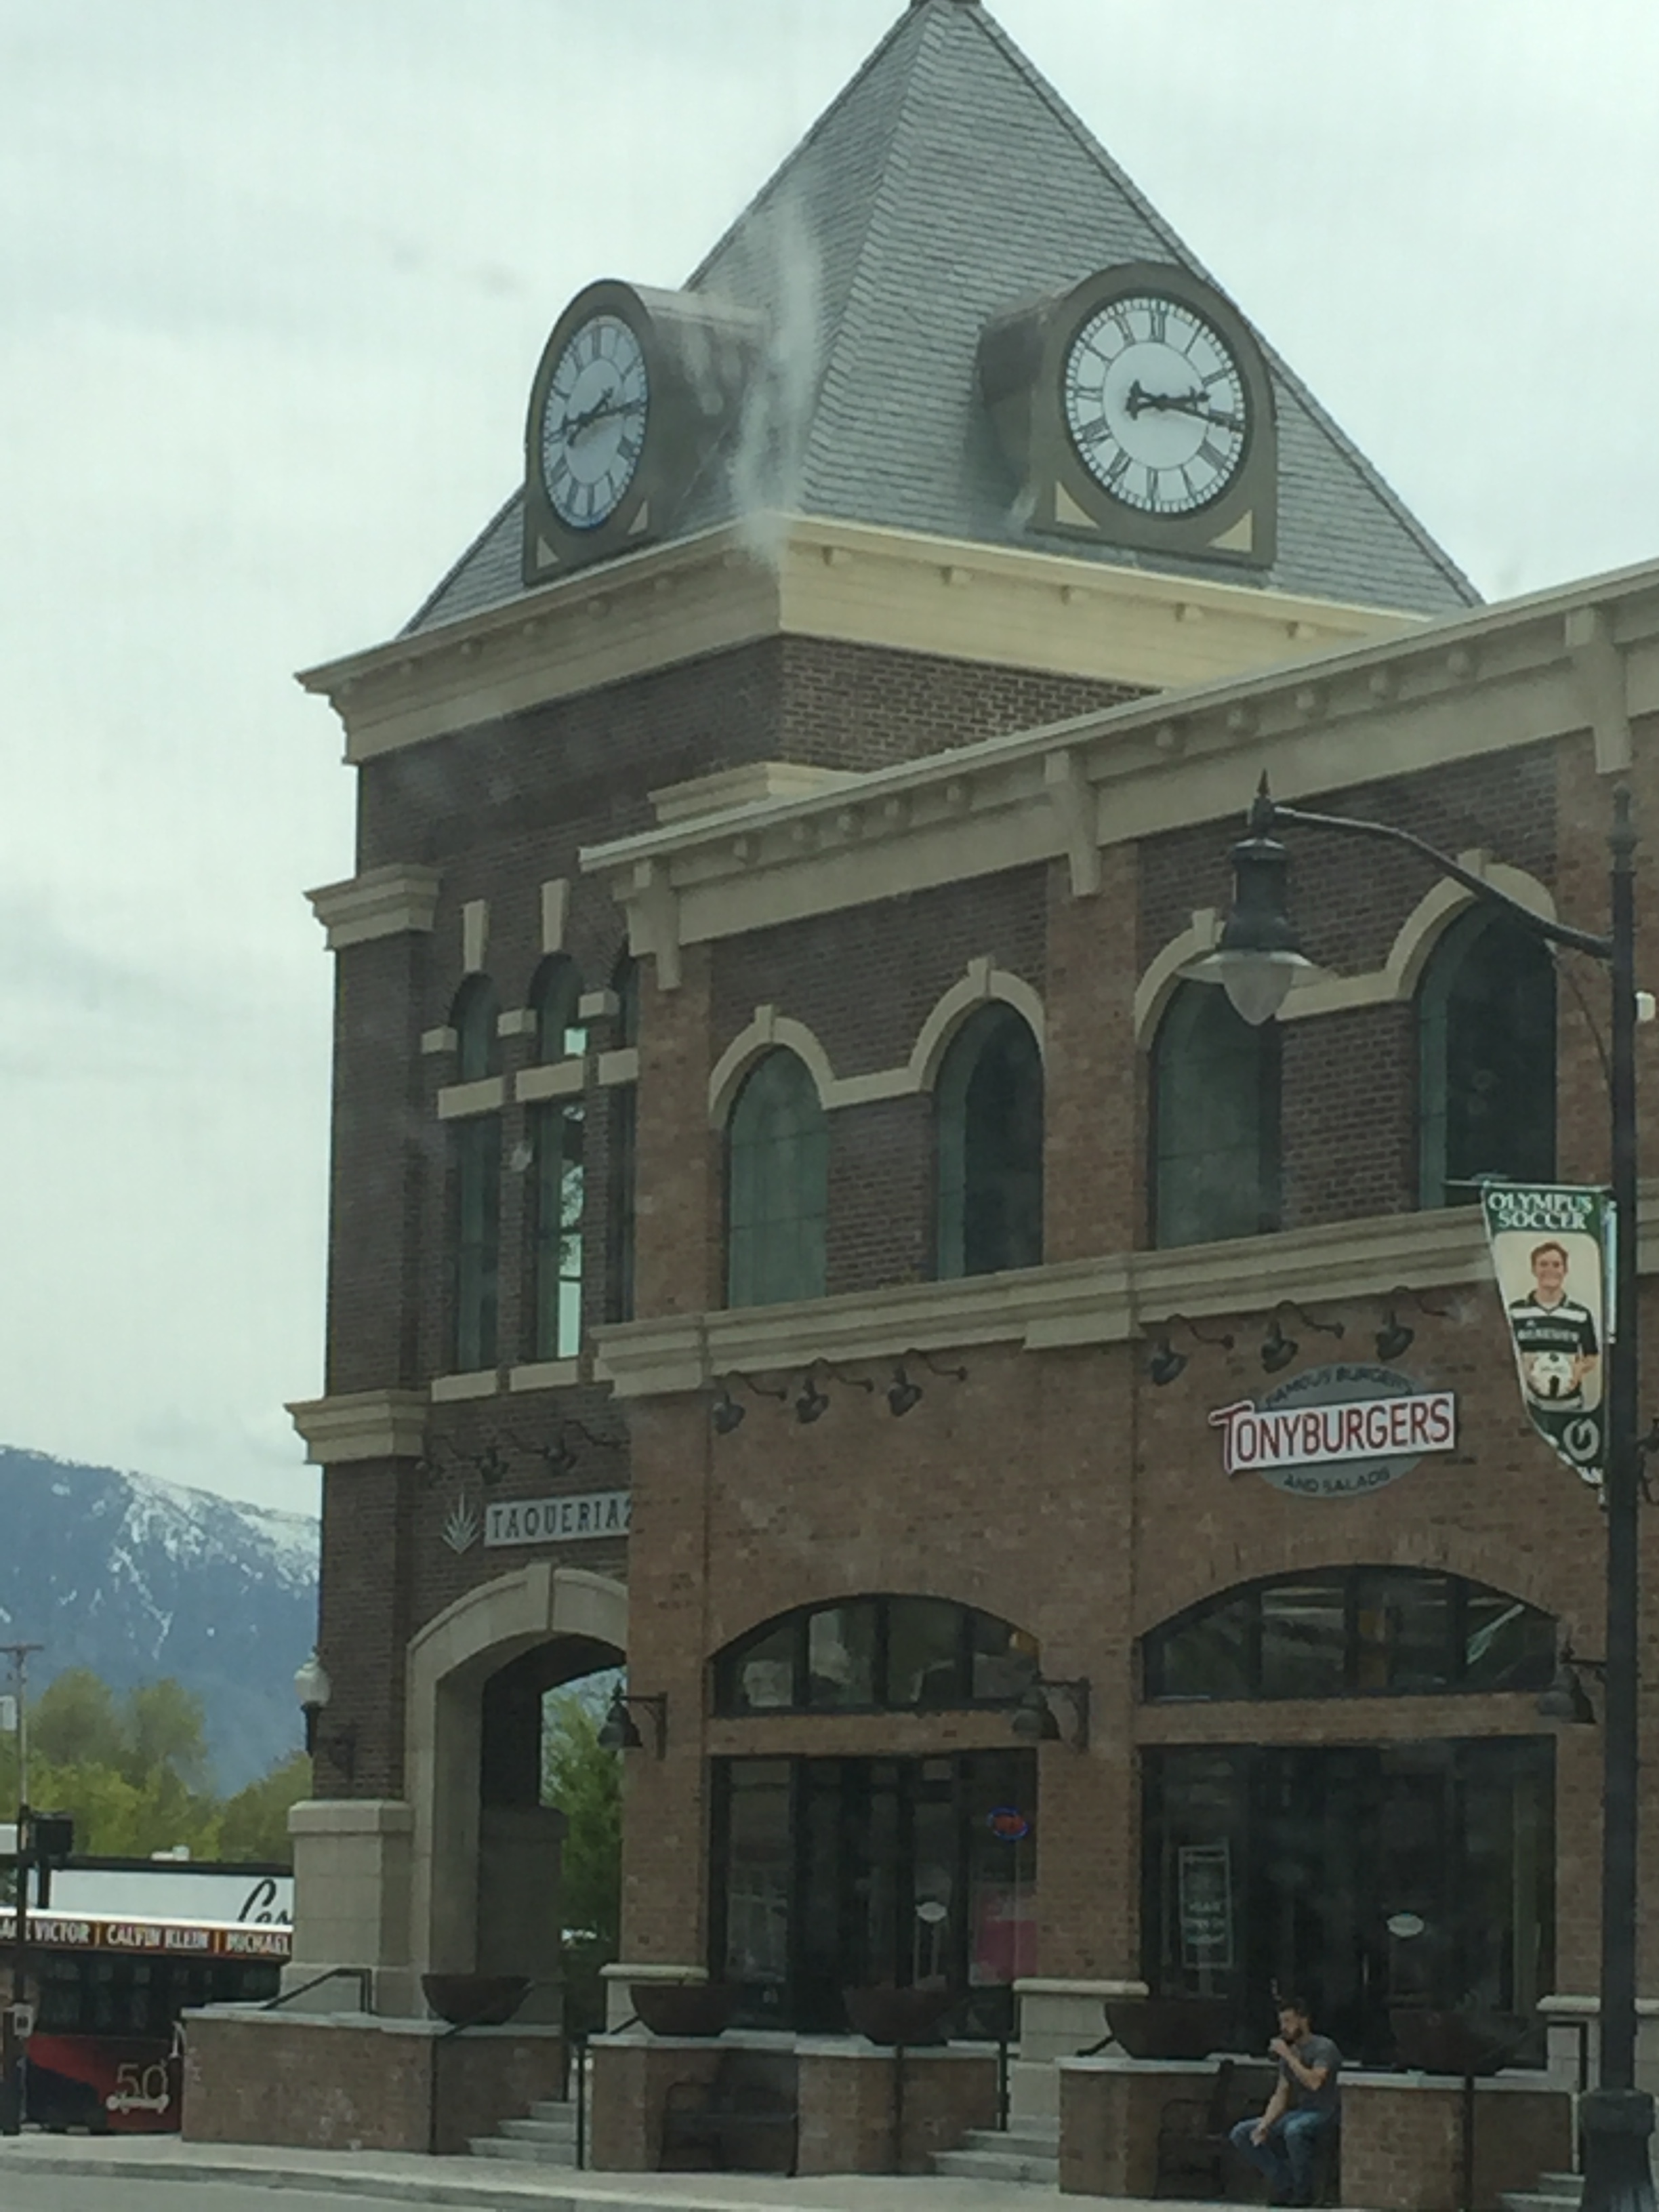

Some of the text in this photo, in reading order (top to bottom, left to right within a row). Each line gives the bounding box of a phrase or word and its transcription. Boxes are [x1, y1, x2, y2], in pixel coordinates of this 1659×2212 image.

[1488, 1191, 1593, 1214] OLYMPUS
[1498, 1210, 1588, 1230] SOCCER
[1210, 1397, 1451, 1471] TONYBURGERS
[491, 1498, 620, 1540] TAQUERIA
[35, 1919, 90, 1944] VICTOR
[106, 1923, 161, 1948] CALVIN
[165, 1928, 210, 1950] KLEIN
[226, 1931, 291, 1956] MICHAEL
